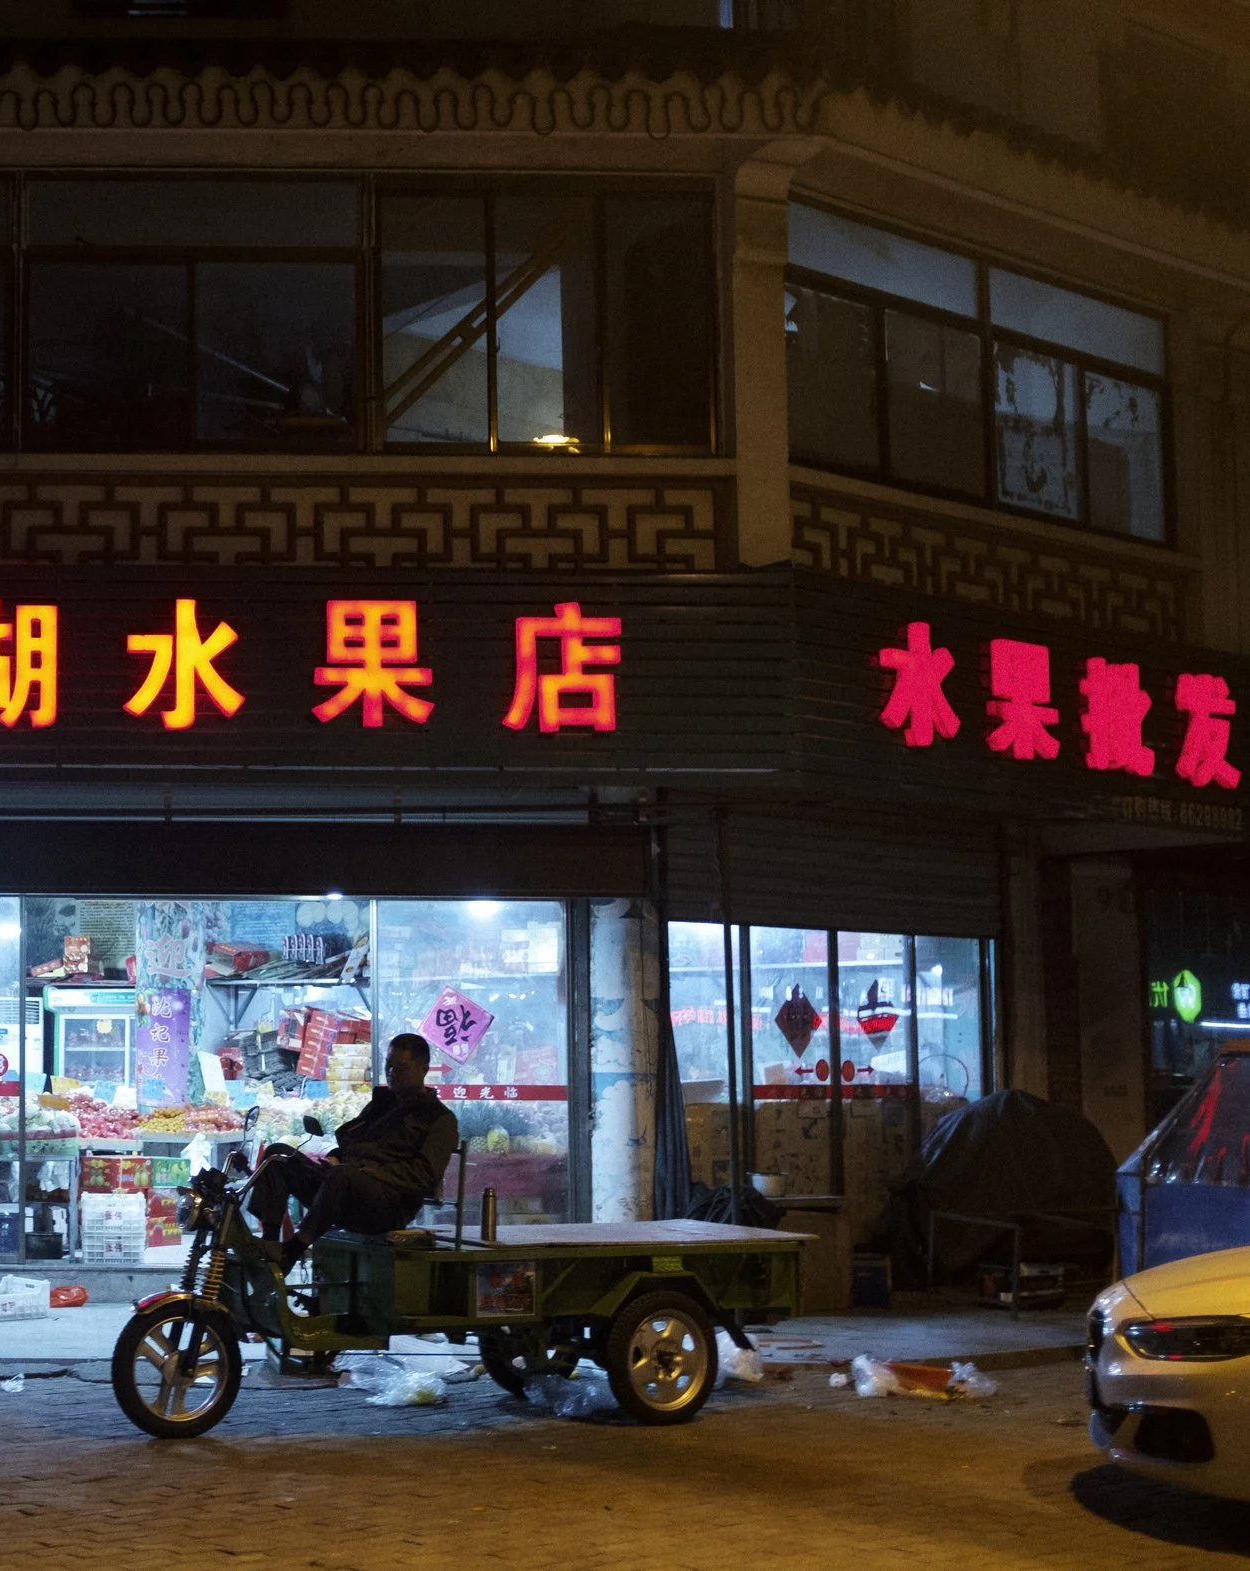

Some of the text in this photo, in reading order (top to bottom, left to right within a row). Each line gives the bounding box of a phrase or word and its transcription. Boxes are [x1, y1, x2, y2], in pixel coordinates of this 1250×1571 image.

[876, 621, 1243, 790] 水果批发
[436, 1005, 477, 1046] 福
